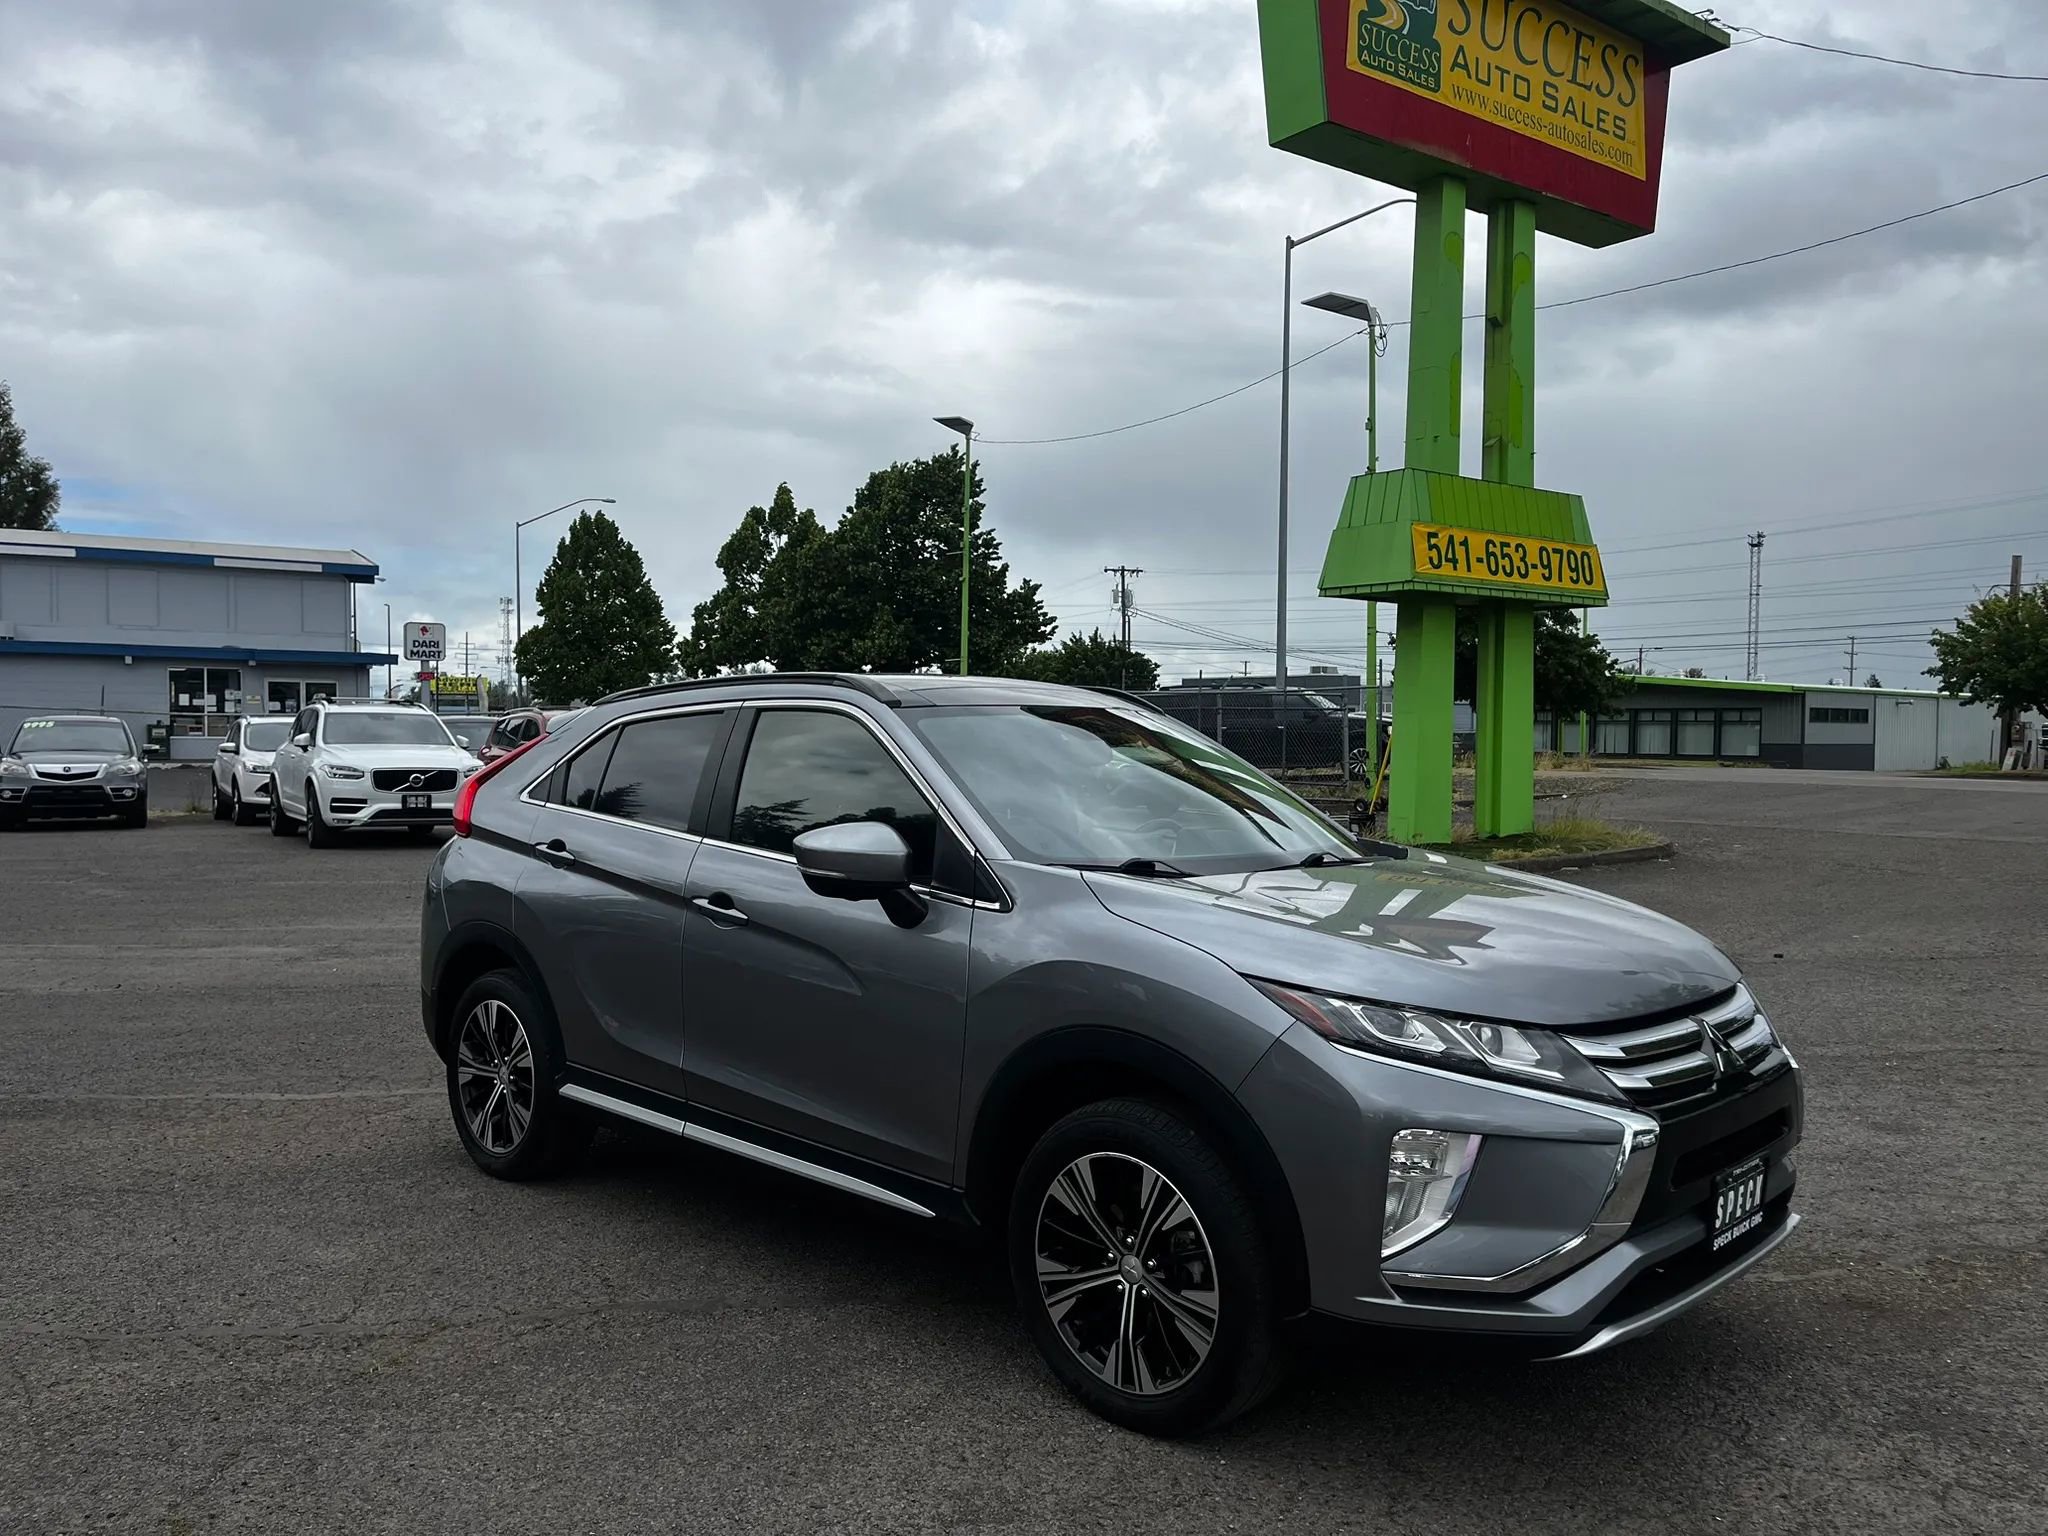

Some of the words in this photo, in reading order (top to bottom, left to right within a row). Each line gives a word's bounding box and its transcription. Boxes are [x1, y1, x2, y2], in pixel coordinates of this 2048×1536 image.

[1360, 23, 1440, 73] SUCCESS
[1361, 50, 1395, 72] AUTO
[1398, 63, 1435, 88] SALES
[1448, 0, 1640, 108] SUCCESS
[1450, 44, 1531, 103] AUTO
[1542, 80, 1627, 141] SALES
[1452, 84, 1633, 168] www.success-autosales.com
[1427, 531, 1594, 586] 541-653-9790
[410, 650, 442, 659] MART
[412, 639, 440, 649] DARI
